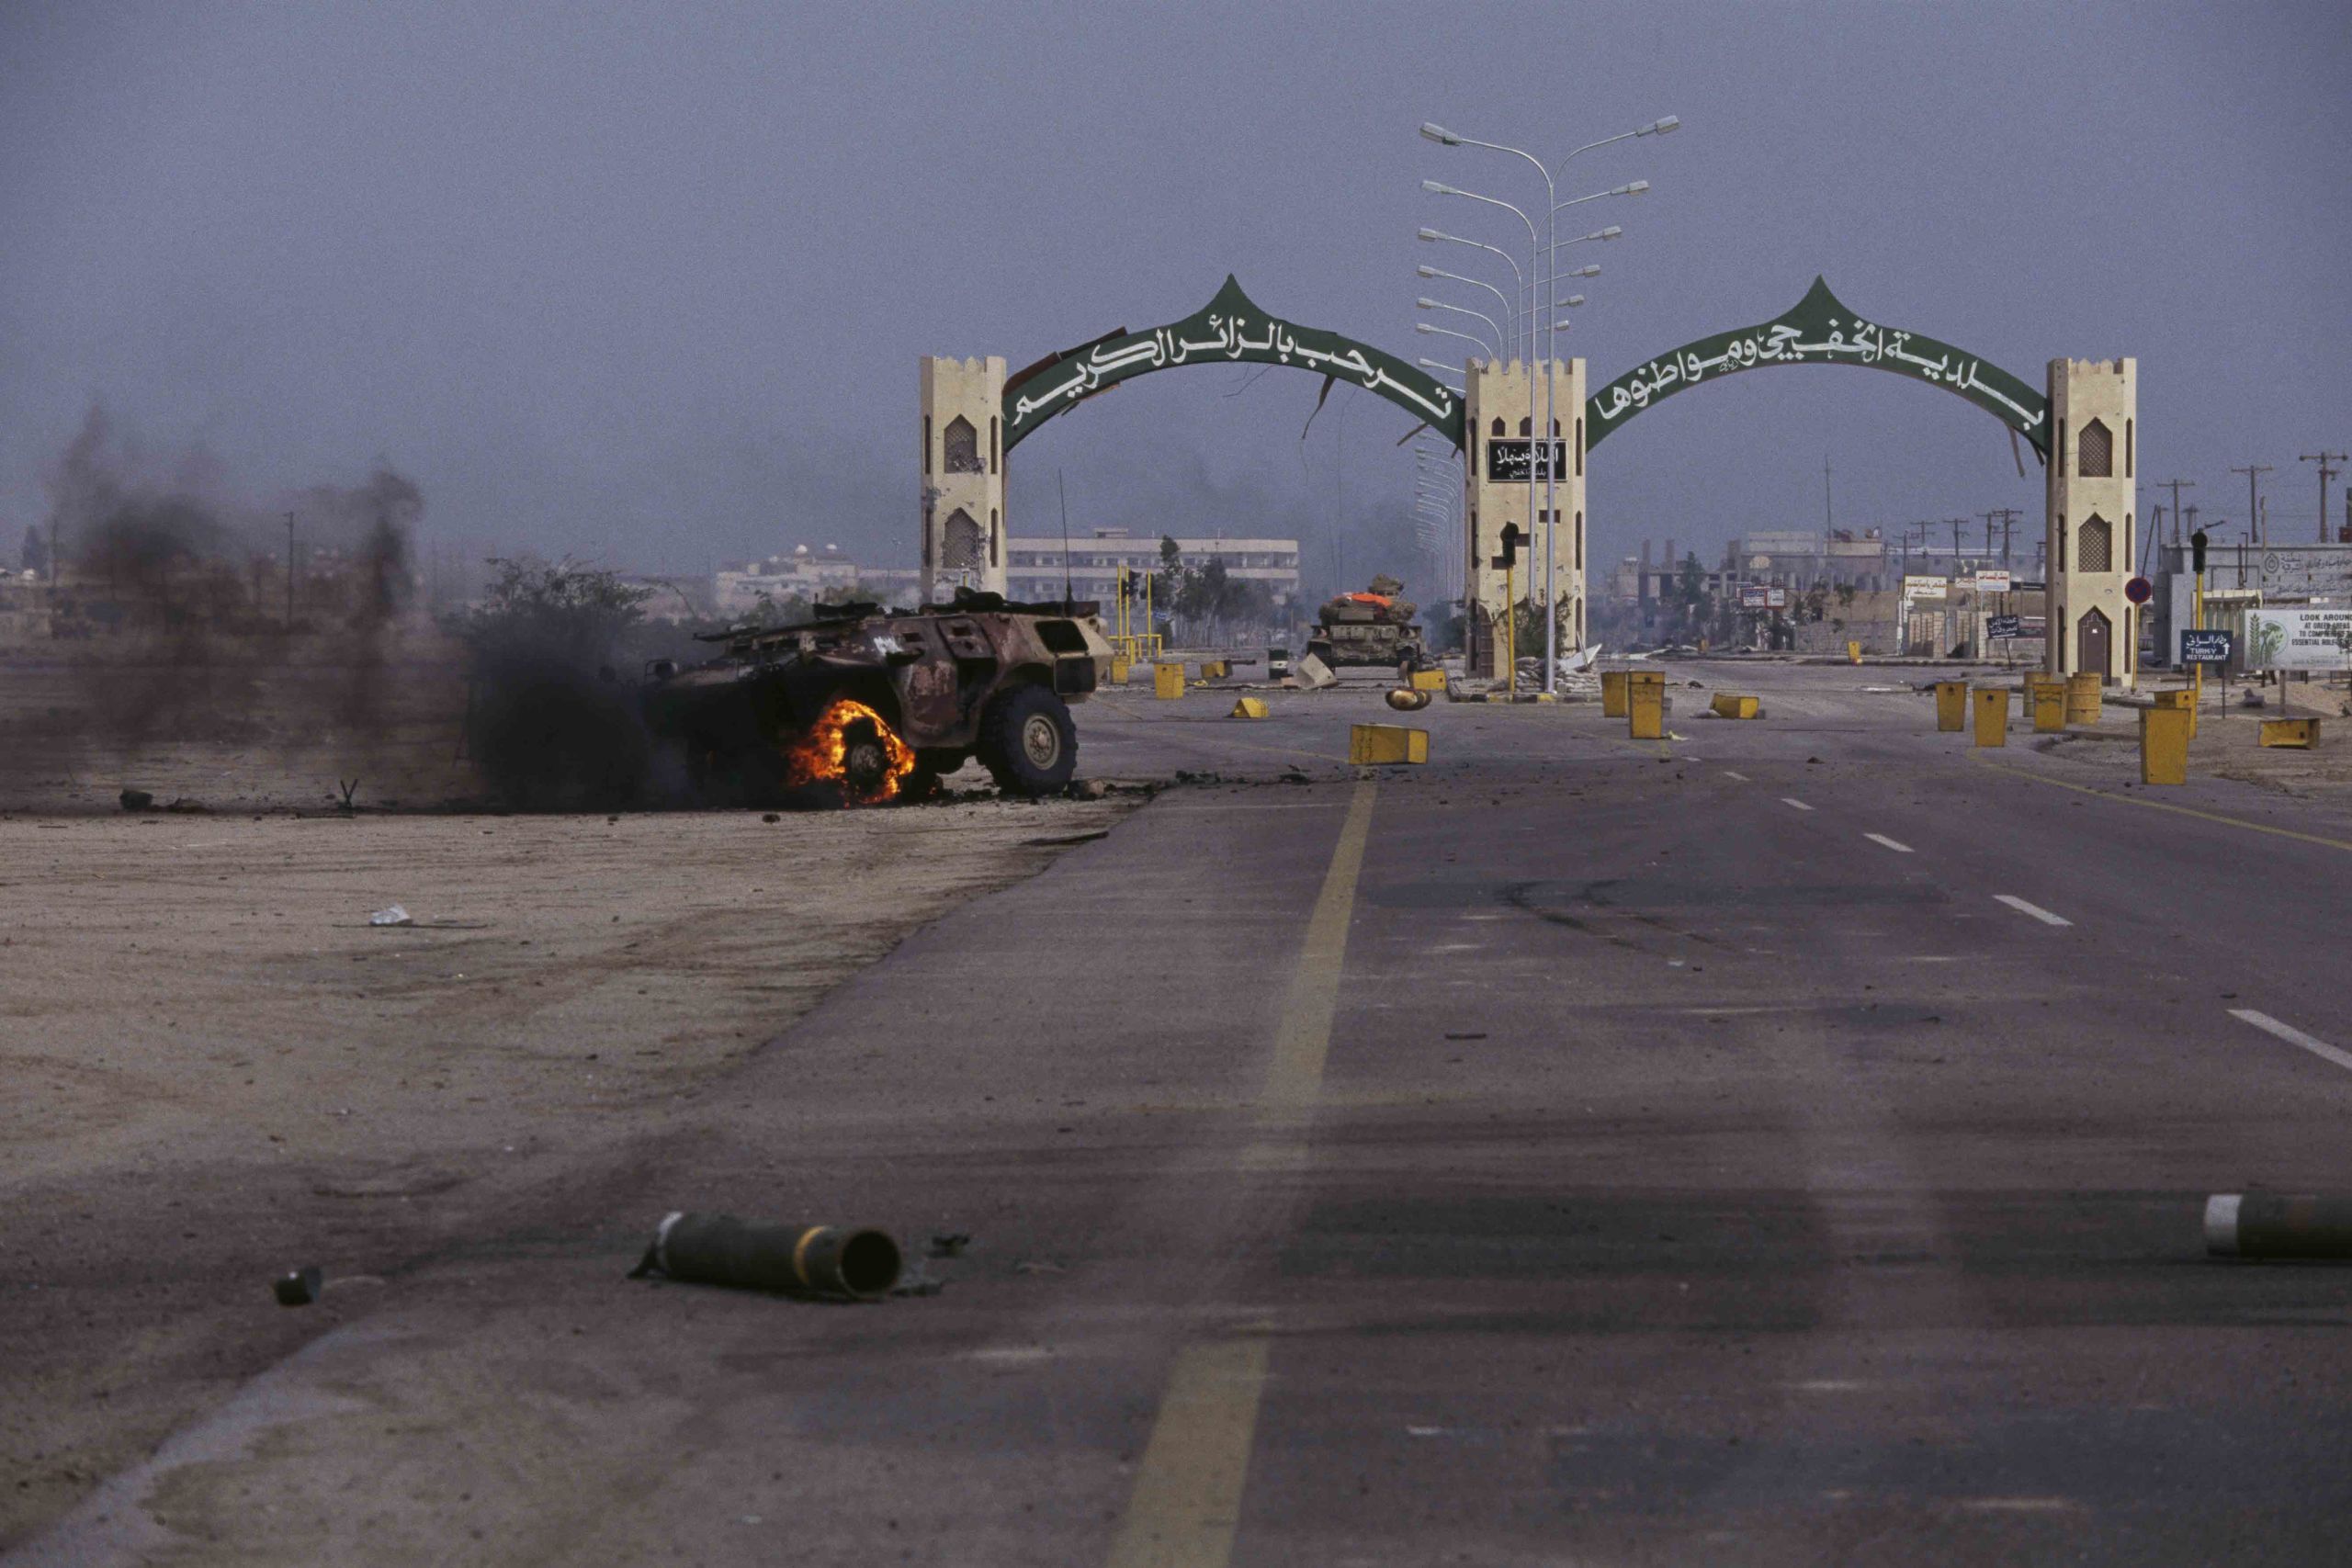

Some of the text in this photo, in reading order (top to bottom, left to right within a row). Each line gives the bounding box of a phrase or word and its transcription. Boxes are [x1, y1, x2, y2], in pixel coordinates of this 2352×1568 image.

[1013, 314, 1452, 424] ترحب بالزائر الكريم
[1758, 319, 1883, 363] الخفجي
[1884, 331, 2044, 430] بلدية
